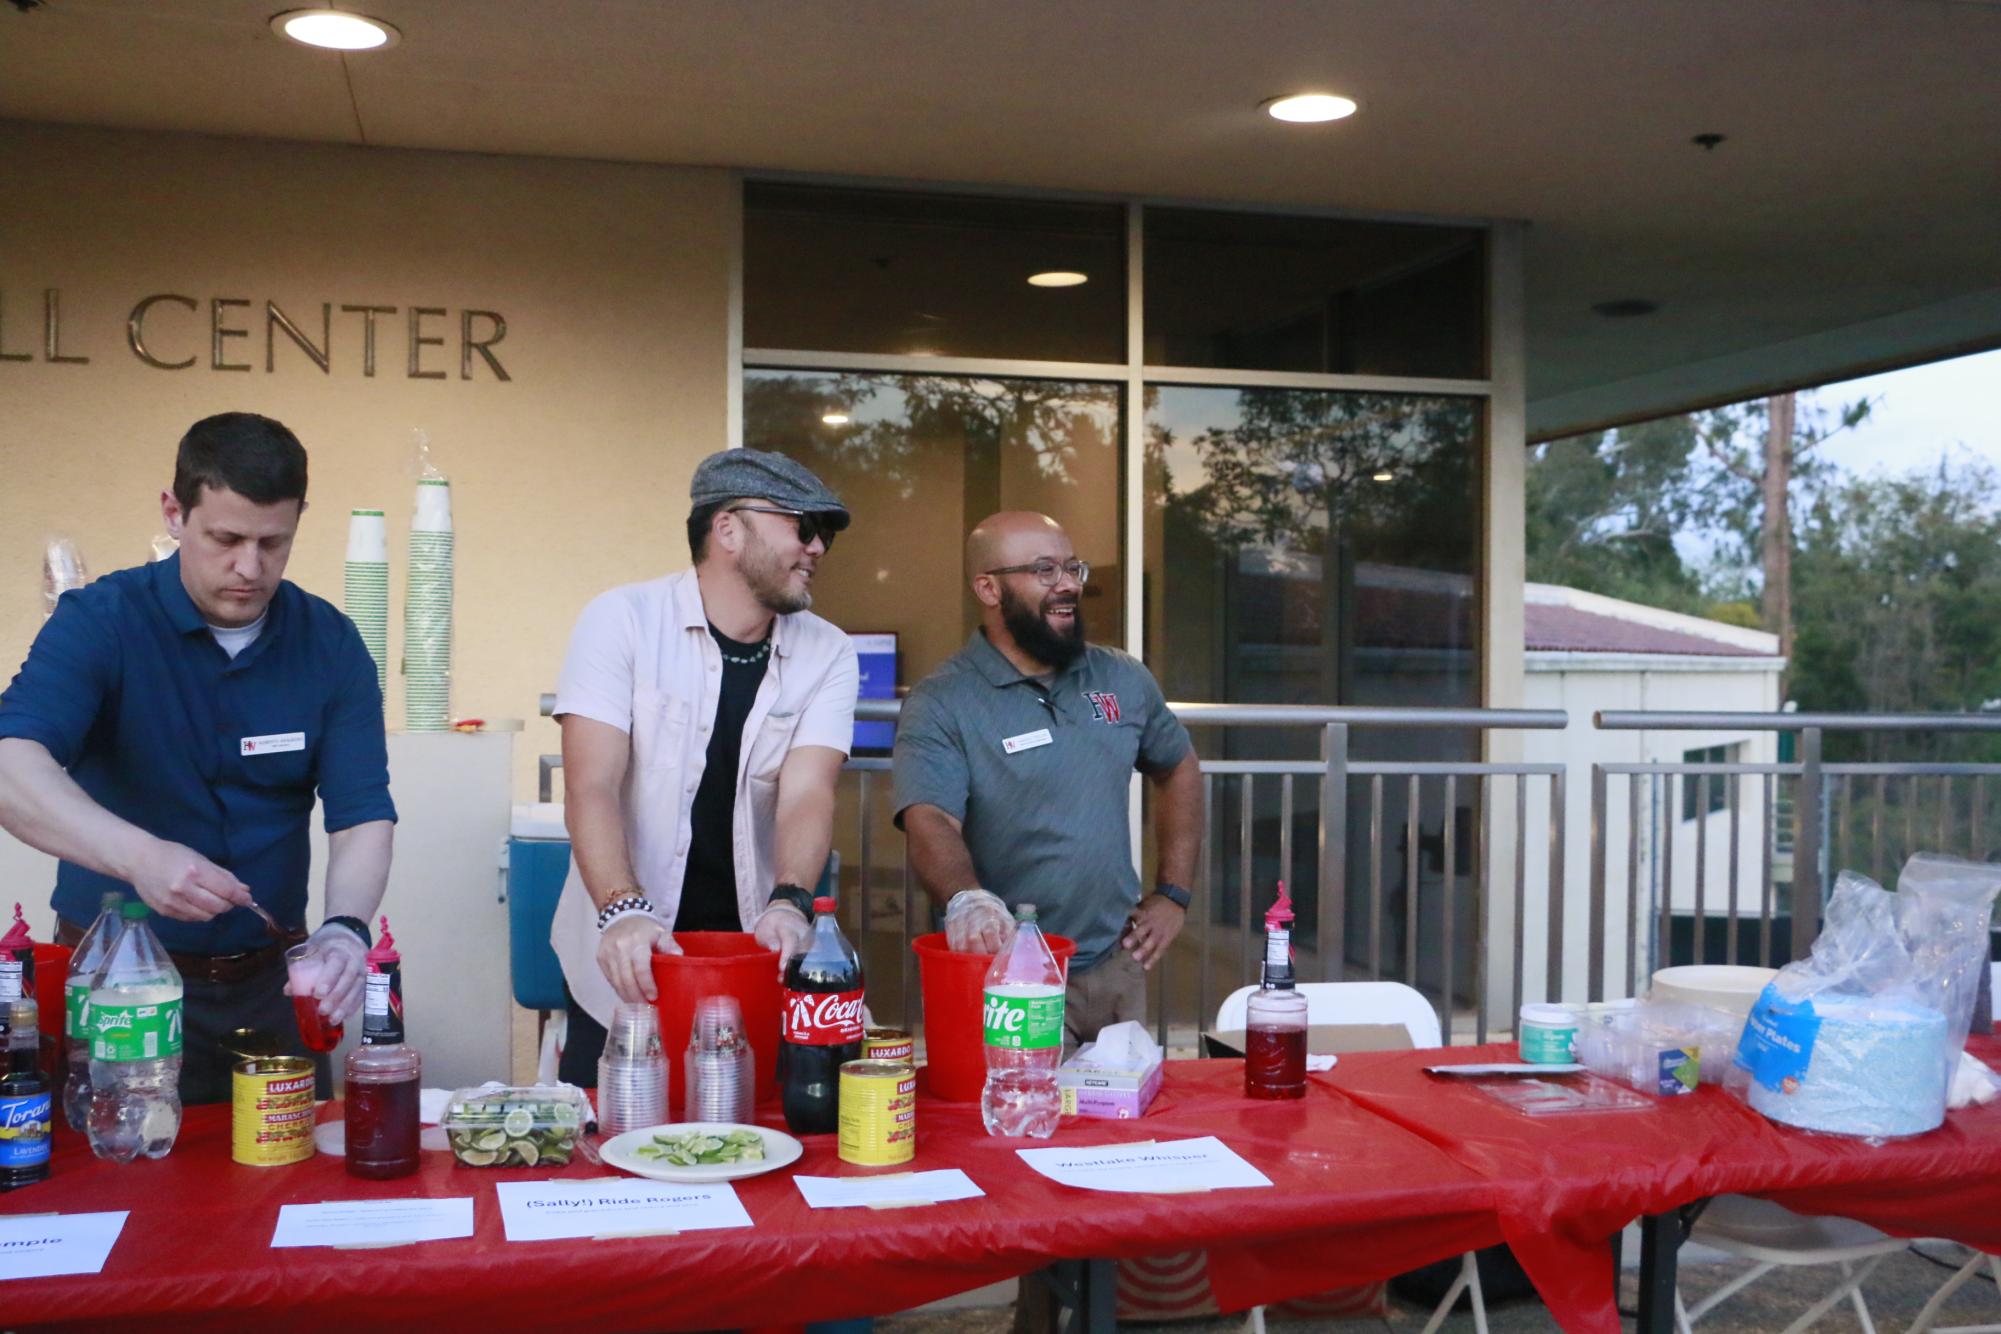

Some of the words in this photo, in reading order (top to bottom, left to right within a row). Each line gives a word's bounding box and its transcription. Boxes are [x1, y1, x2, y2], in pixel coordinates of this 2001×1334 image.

[127, 294, 512, 382] CENTER
[871, 1045, 912, 1059] LUXARDO
[1056, 1158, 1136, 1168] Westlake
[1138, 1154, 1208, 1162] Whisper
[526, 1199, 594, 1209] (Sally!)
[599, 1197, 641, 1206] Ride
[646, 1193, 712, 1204] Rogers
[0, 1238, 63, 1247] mple
